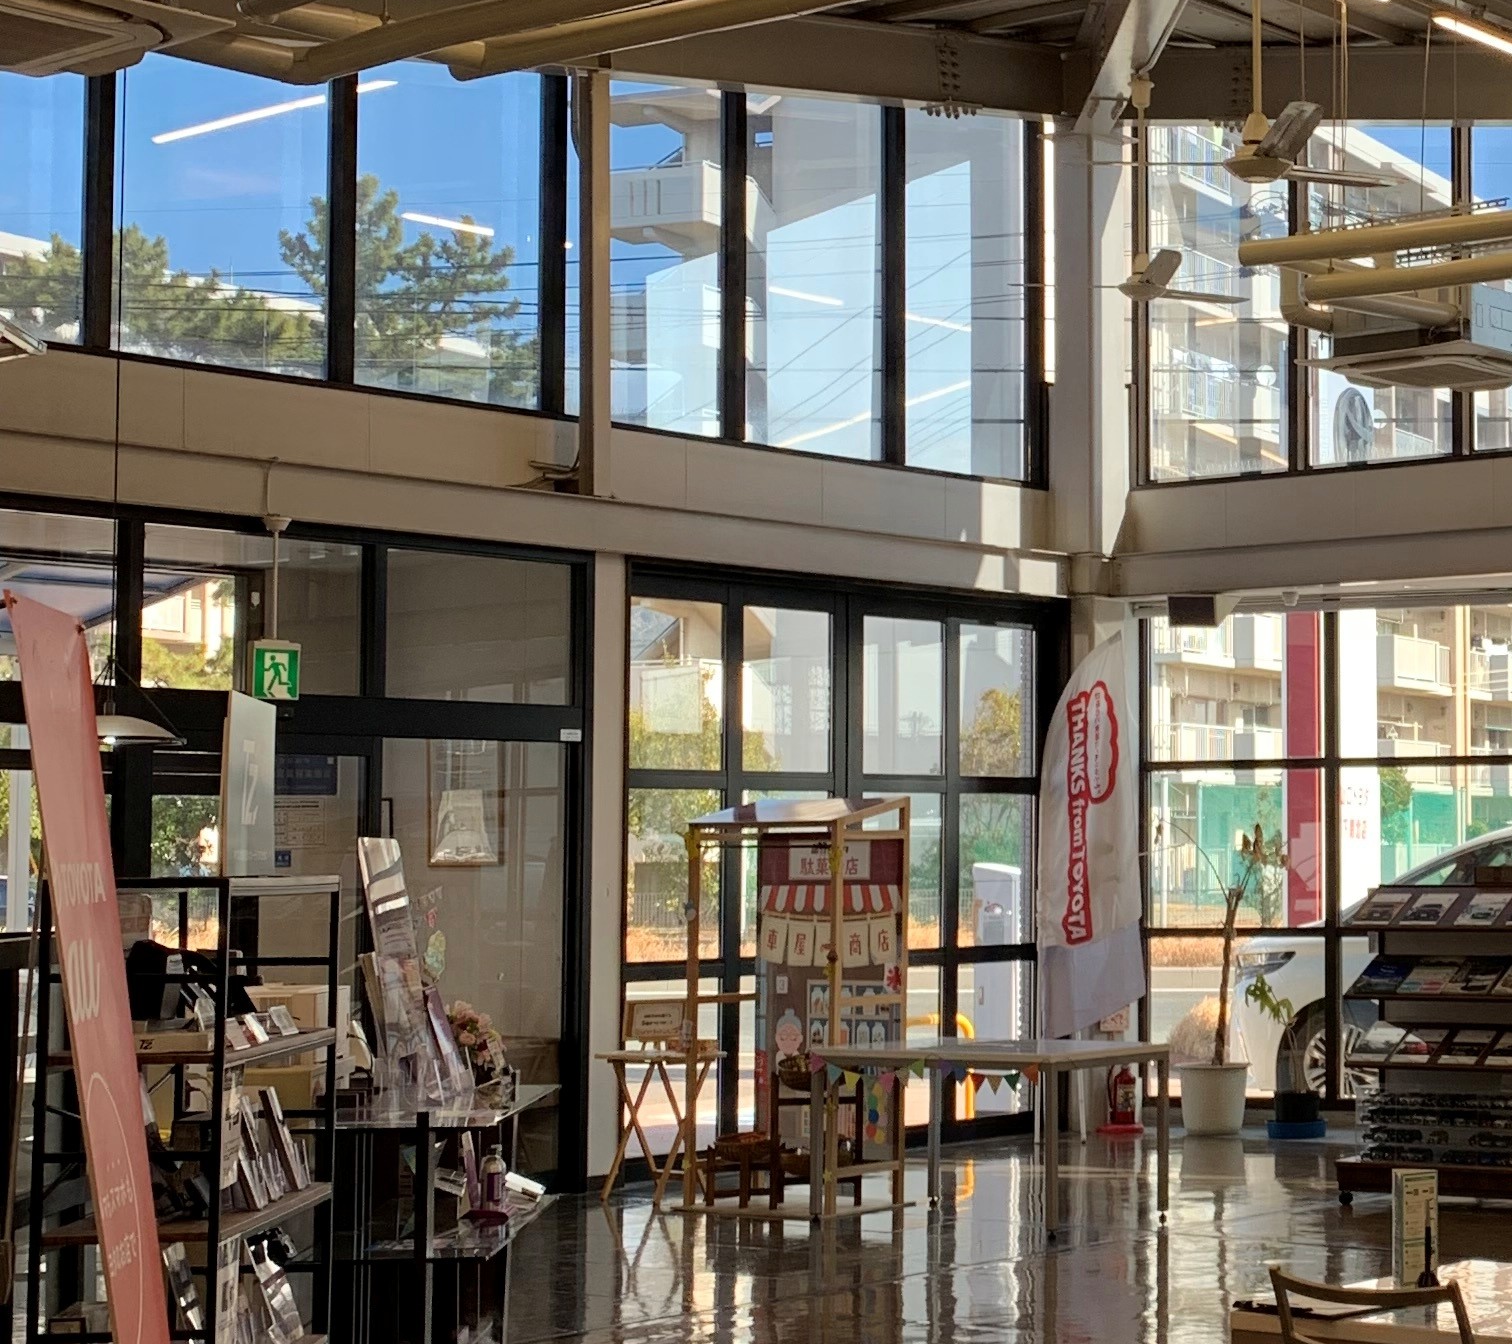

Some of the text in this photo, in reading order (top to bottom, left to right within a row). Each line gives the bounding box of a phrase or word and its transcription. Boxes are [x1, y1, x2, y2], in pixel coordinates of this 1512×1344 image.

[1067, 697, 1087, 940] THANKS from TOYOTA
[58, 862, 107, 906] TOYOTA
[800, 857, 860, 876] 駄菓店
